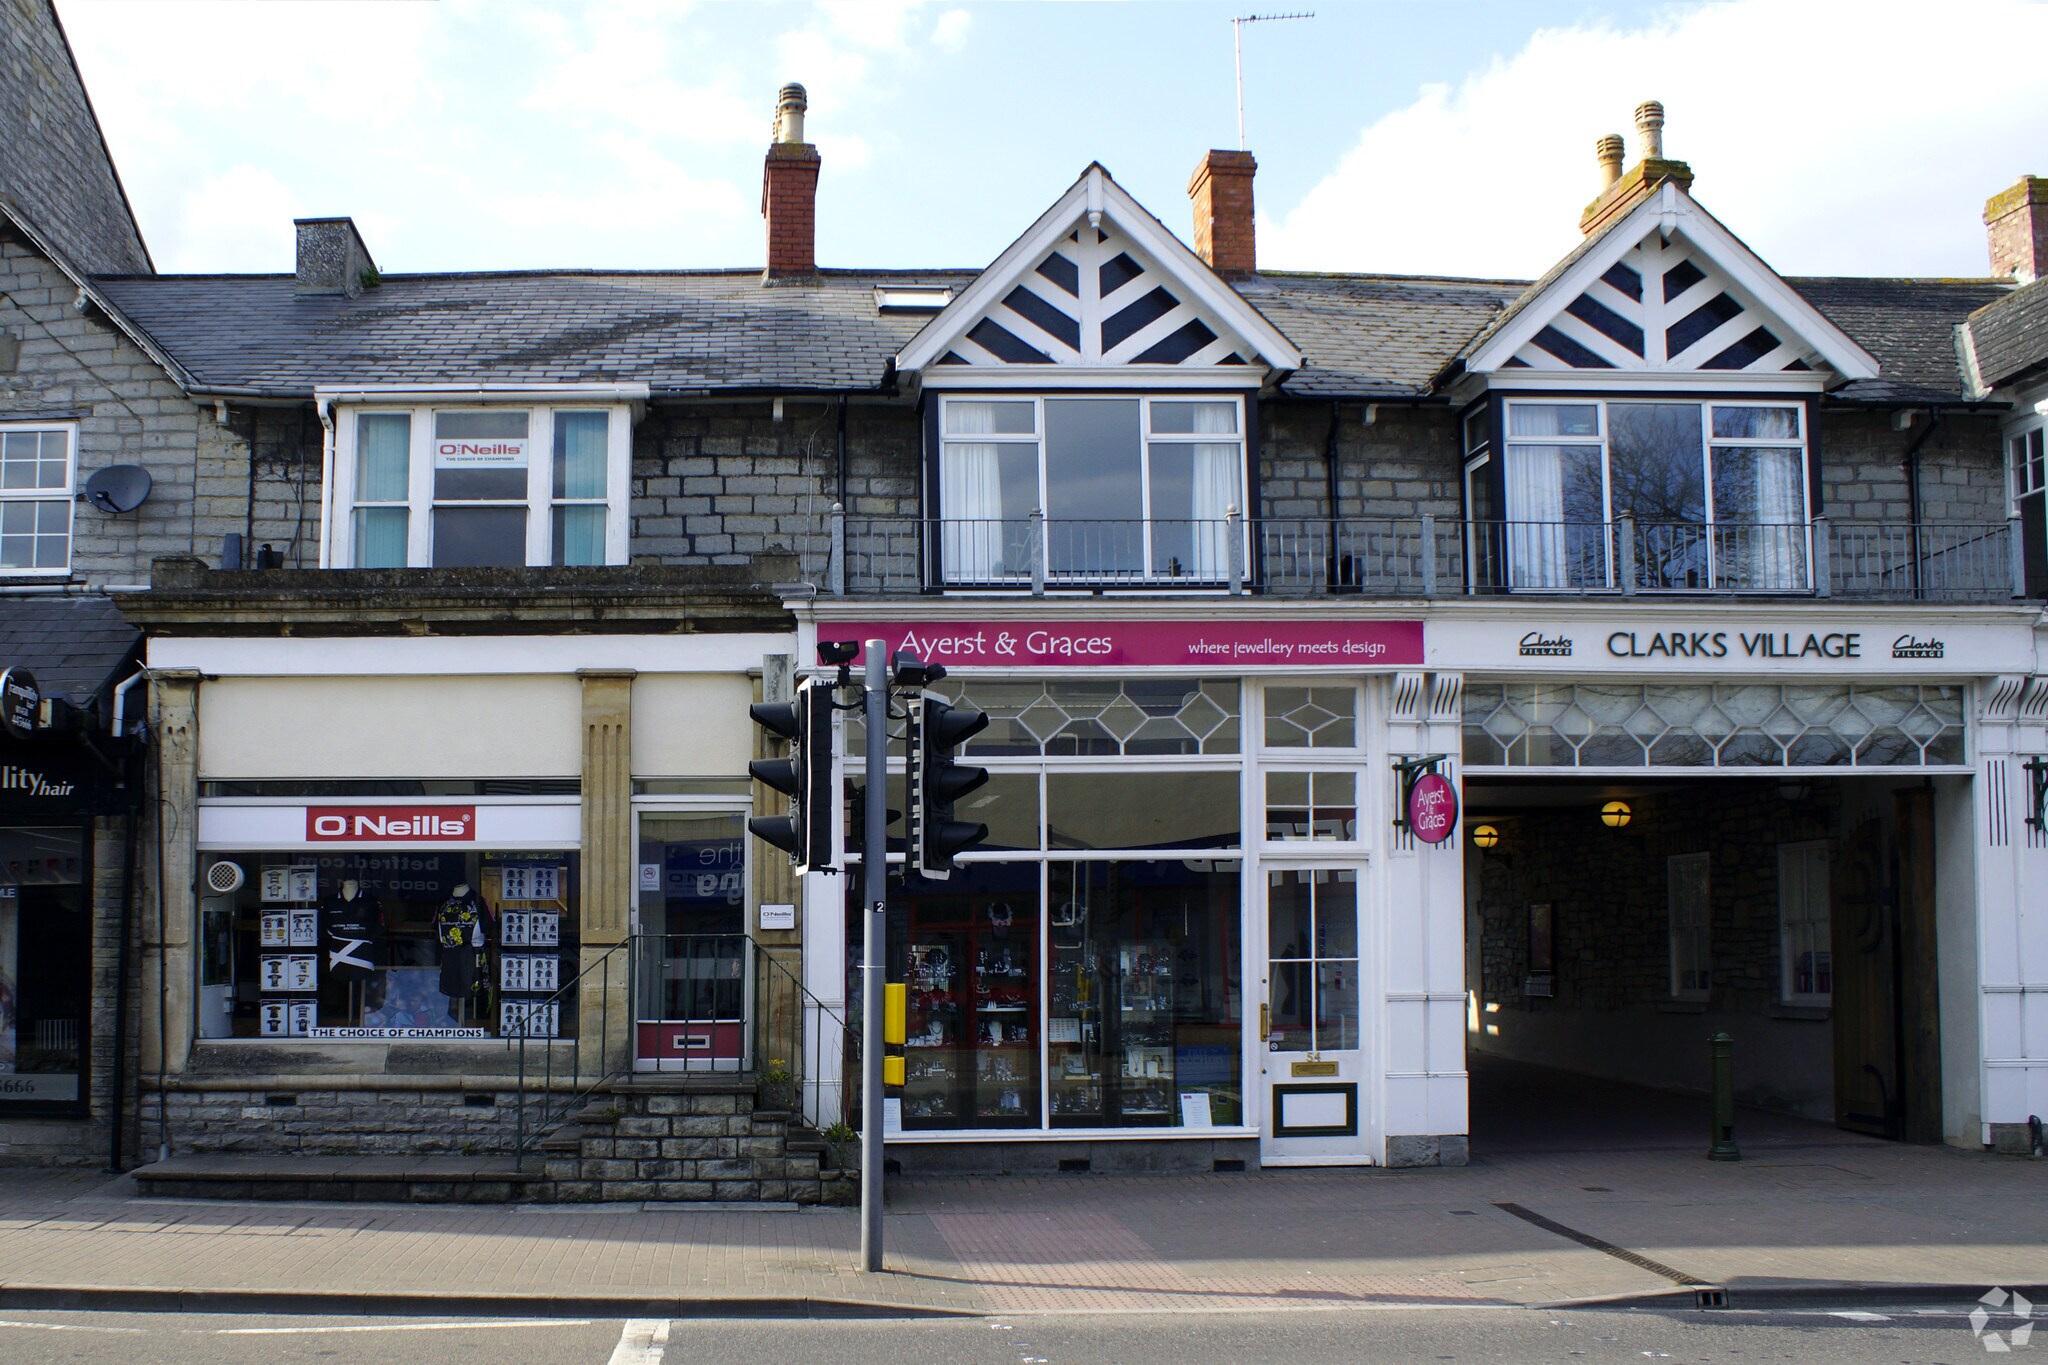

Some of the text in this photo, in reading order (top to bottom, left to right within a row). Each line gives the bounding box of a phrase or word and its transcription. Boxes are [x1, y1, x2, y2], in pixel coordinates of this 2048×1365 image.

[898, 631, 1112, 663] Ayerst & Graces
[1520, 632, 1573, 647] Clarks
[1607, 632, 1861, 658] CLARKS VILLAGE
[1892, 634, 1944, 650] Clarks
[1189, 639, 1386, 658] where jewellery meets design
[39, 781, 74, 796] hair
[1417, 785, 1445, 812] Ayerst
[1418, 812, 1446, 830] Graces
[877, 902, 884, 912] 2
[311, 1028, 482, 1037] THE CHOICE OF CHAMPIONS
[1306, 1052, 1320, 1063] 54
